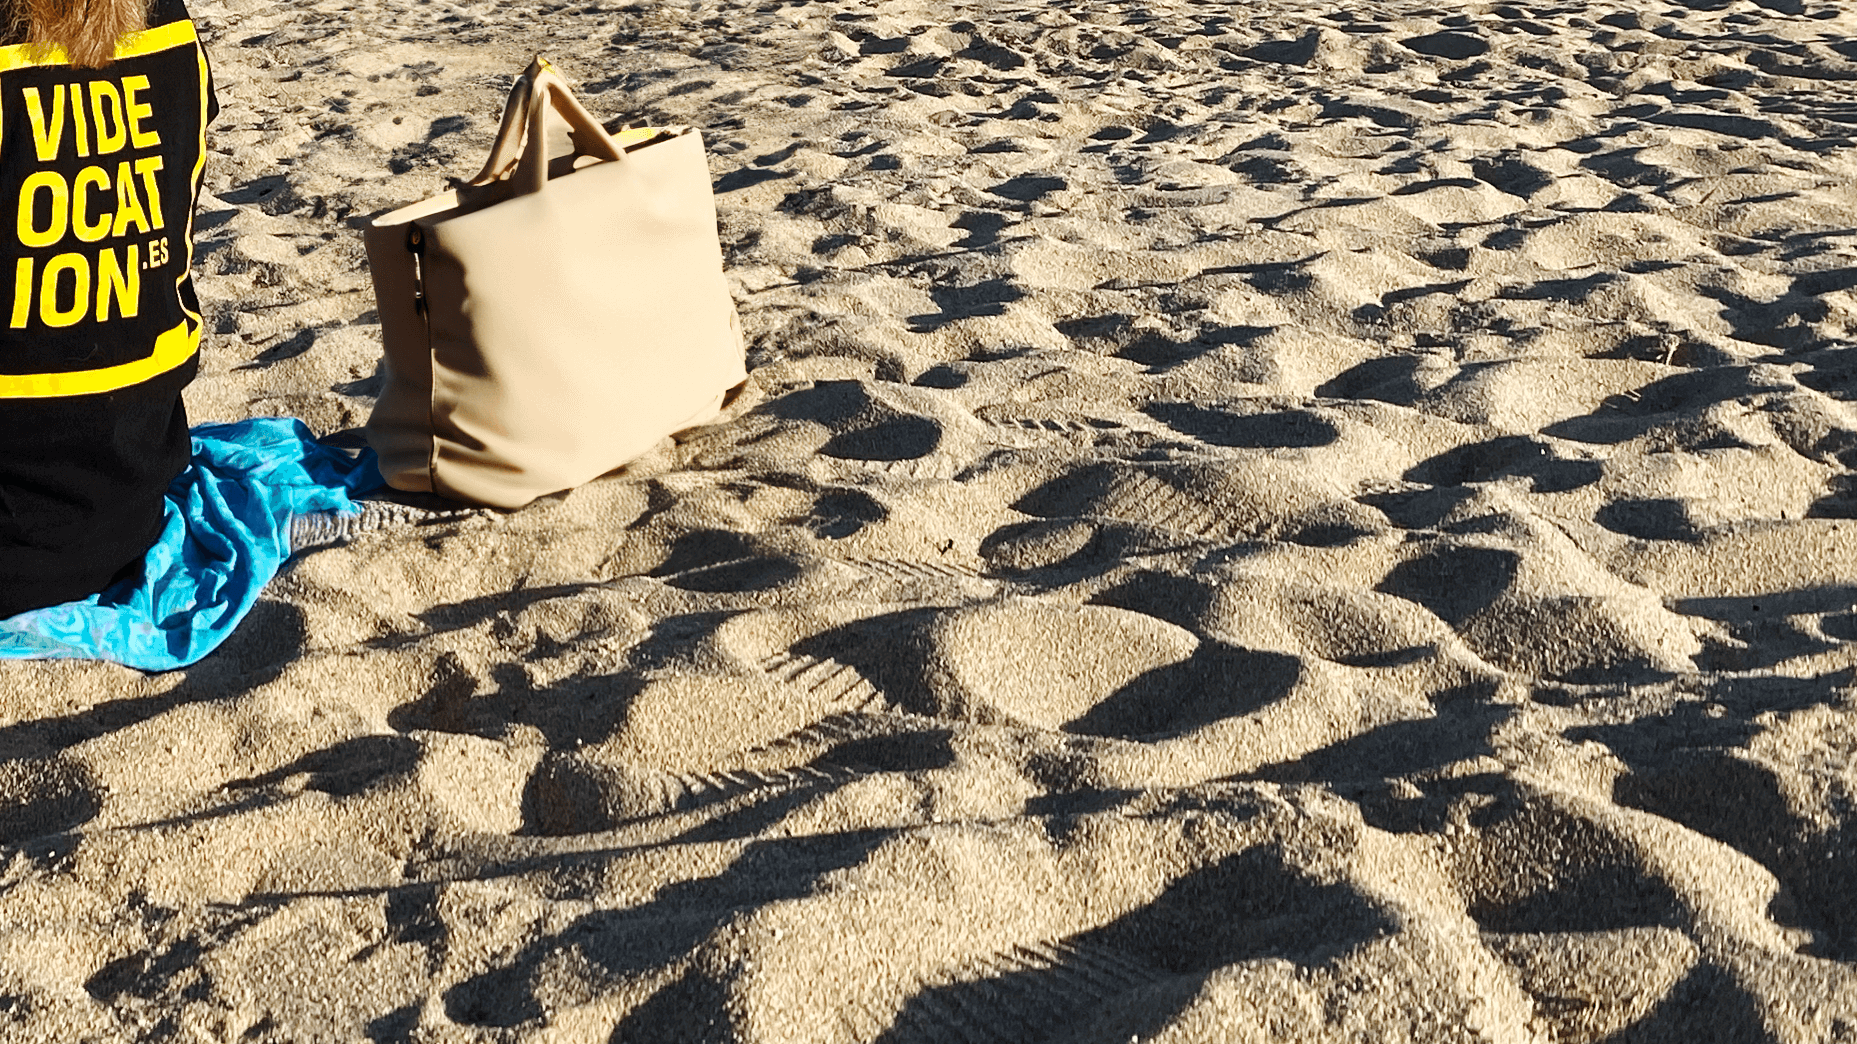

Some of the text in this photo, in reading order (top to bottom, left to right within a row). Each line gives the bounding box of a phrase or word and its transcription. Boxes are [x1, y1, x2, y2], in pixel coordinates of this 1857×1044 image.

[22, 74, 161, 162] VIDE
[16, 155, 164, 248] OCAT
[9, 244, 140, 329] ION
